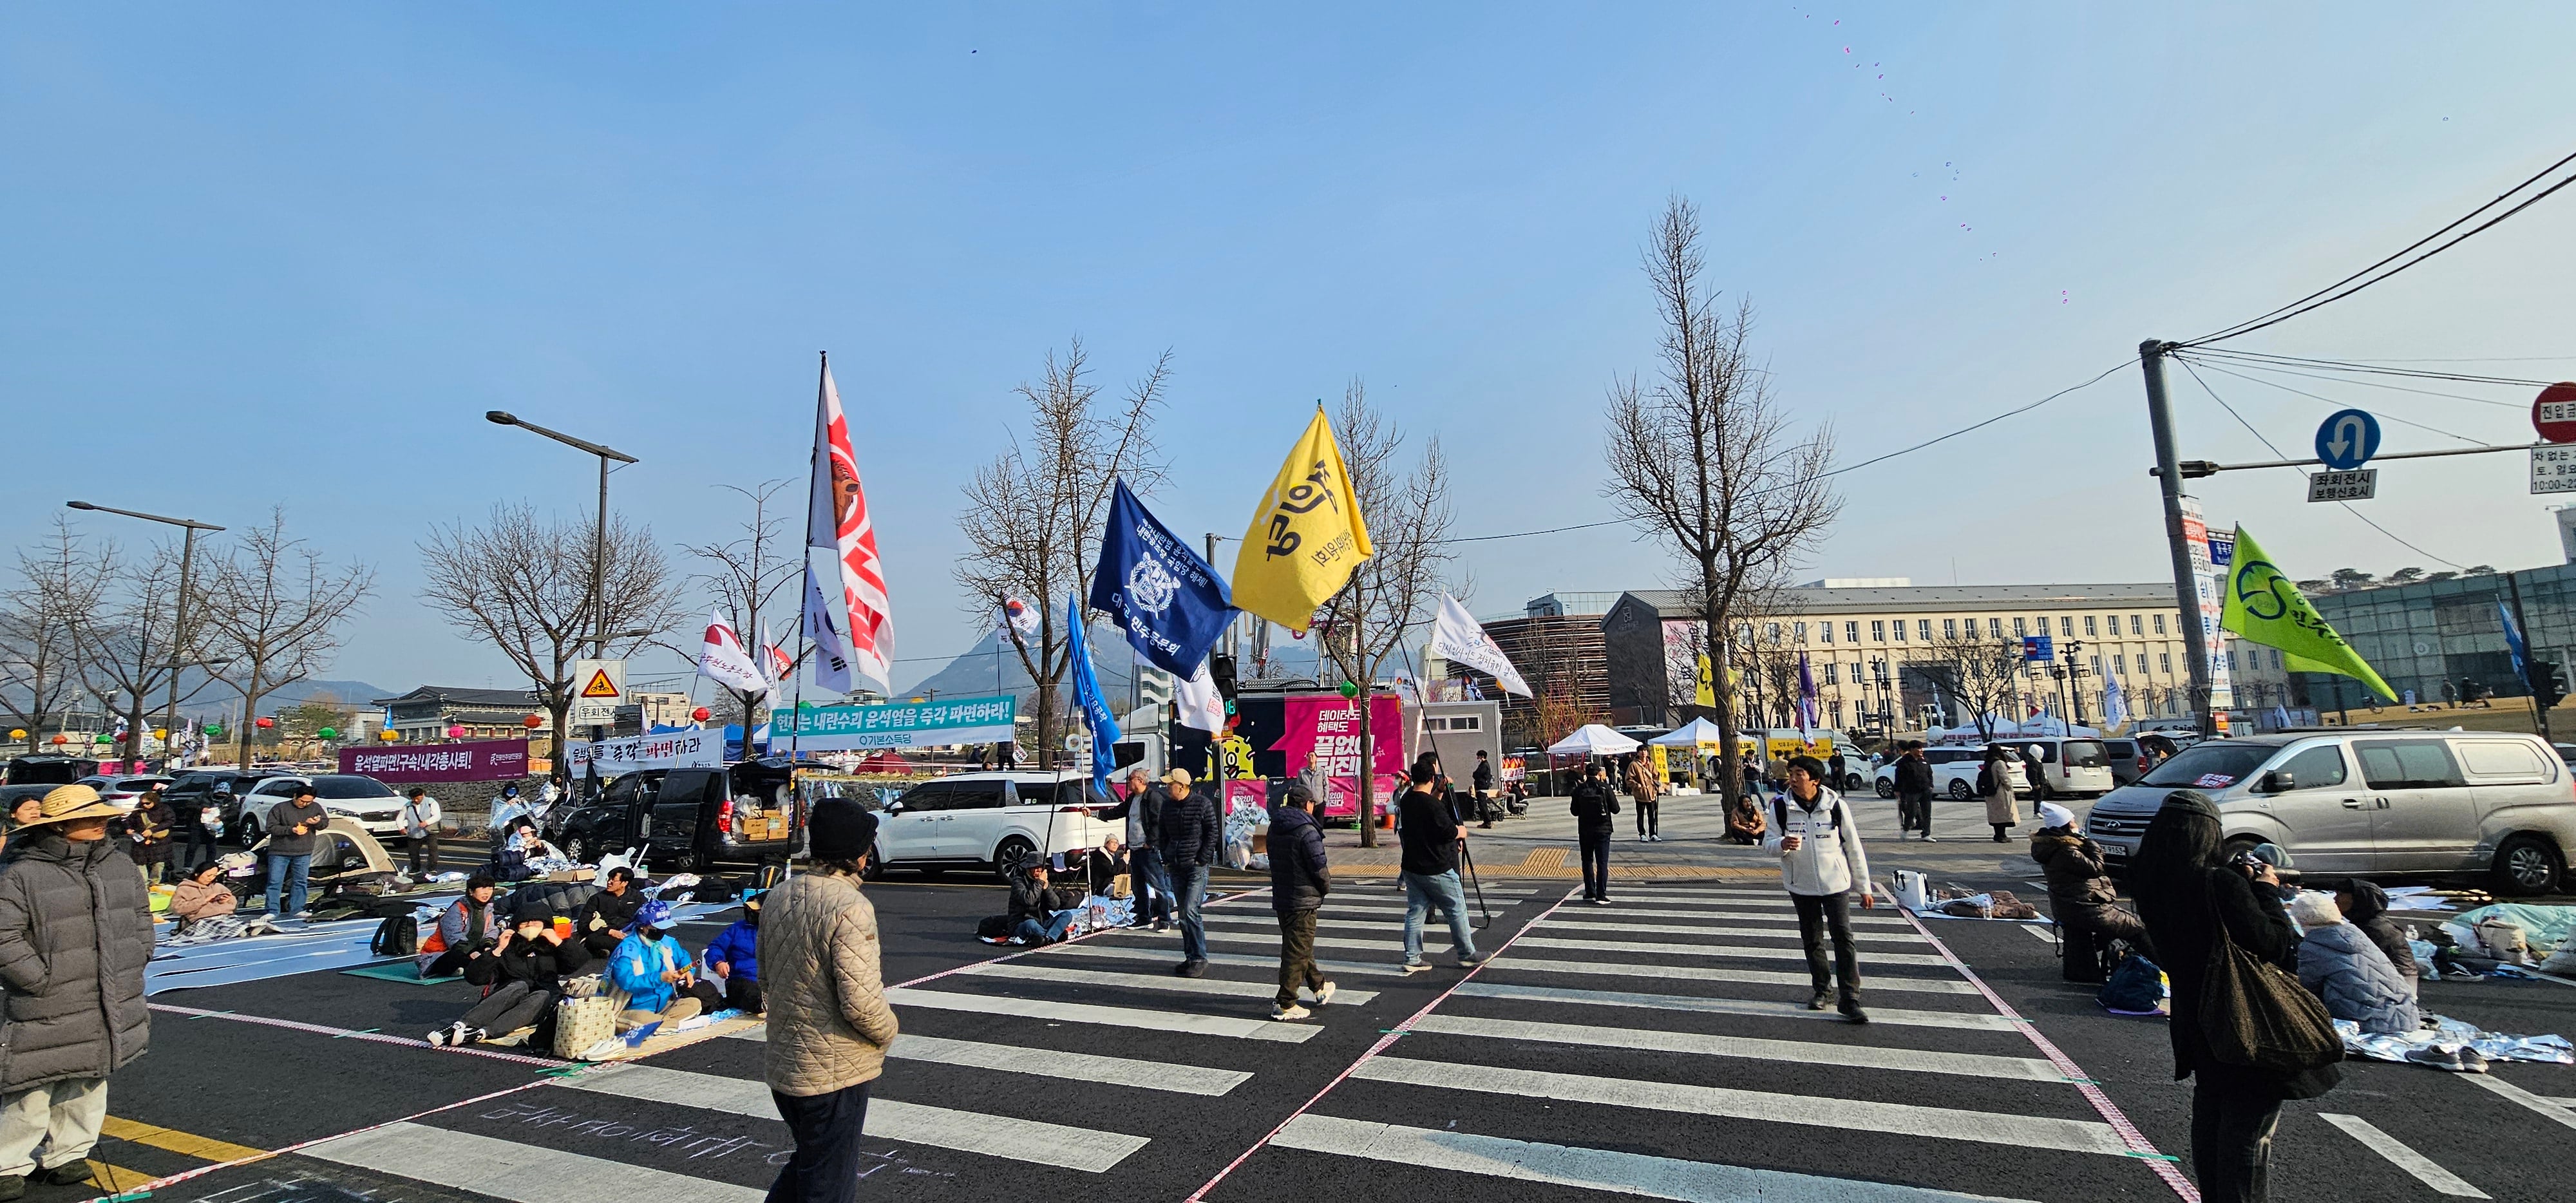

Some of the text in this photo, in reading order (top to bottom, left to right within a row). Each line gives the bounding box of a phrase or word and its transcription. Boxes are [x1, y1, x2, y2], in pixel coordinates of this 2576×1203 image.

[2533, 450, 2569, 462] 차 없는
[2316, 472, 2370, 486] 좌회전시
[2315, 486, 2369, 499] 보행신호시
[1166, 556, 1189, 576] 국힘당
[1189, 571, 1209, 589] 해체!
[1131, 616, 1182, 656] 민주동문회
[1437, 642, 1475, 661] 디시인사이드
[813, 710, 863, 730] 내란수괴
[865, 708, 917, 728] 윤석열을
[920, 706, 947, 725] 즉각
[949, 701, 1010, 723] 파면하라!
[1318, 710, 1360, 721] 데이터도
[1317, 721, 1349, 732] 혜택도
[869, 735, 912, 746] 기본소득당
[646, 737, 701, 759] 파면하라
